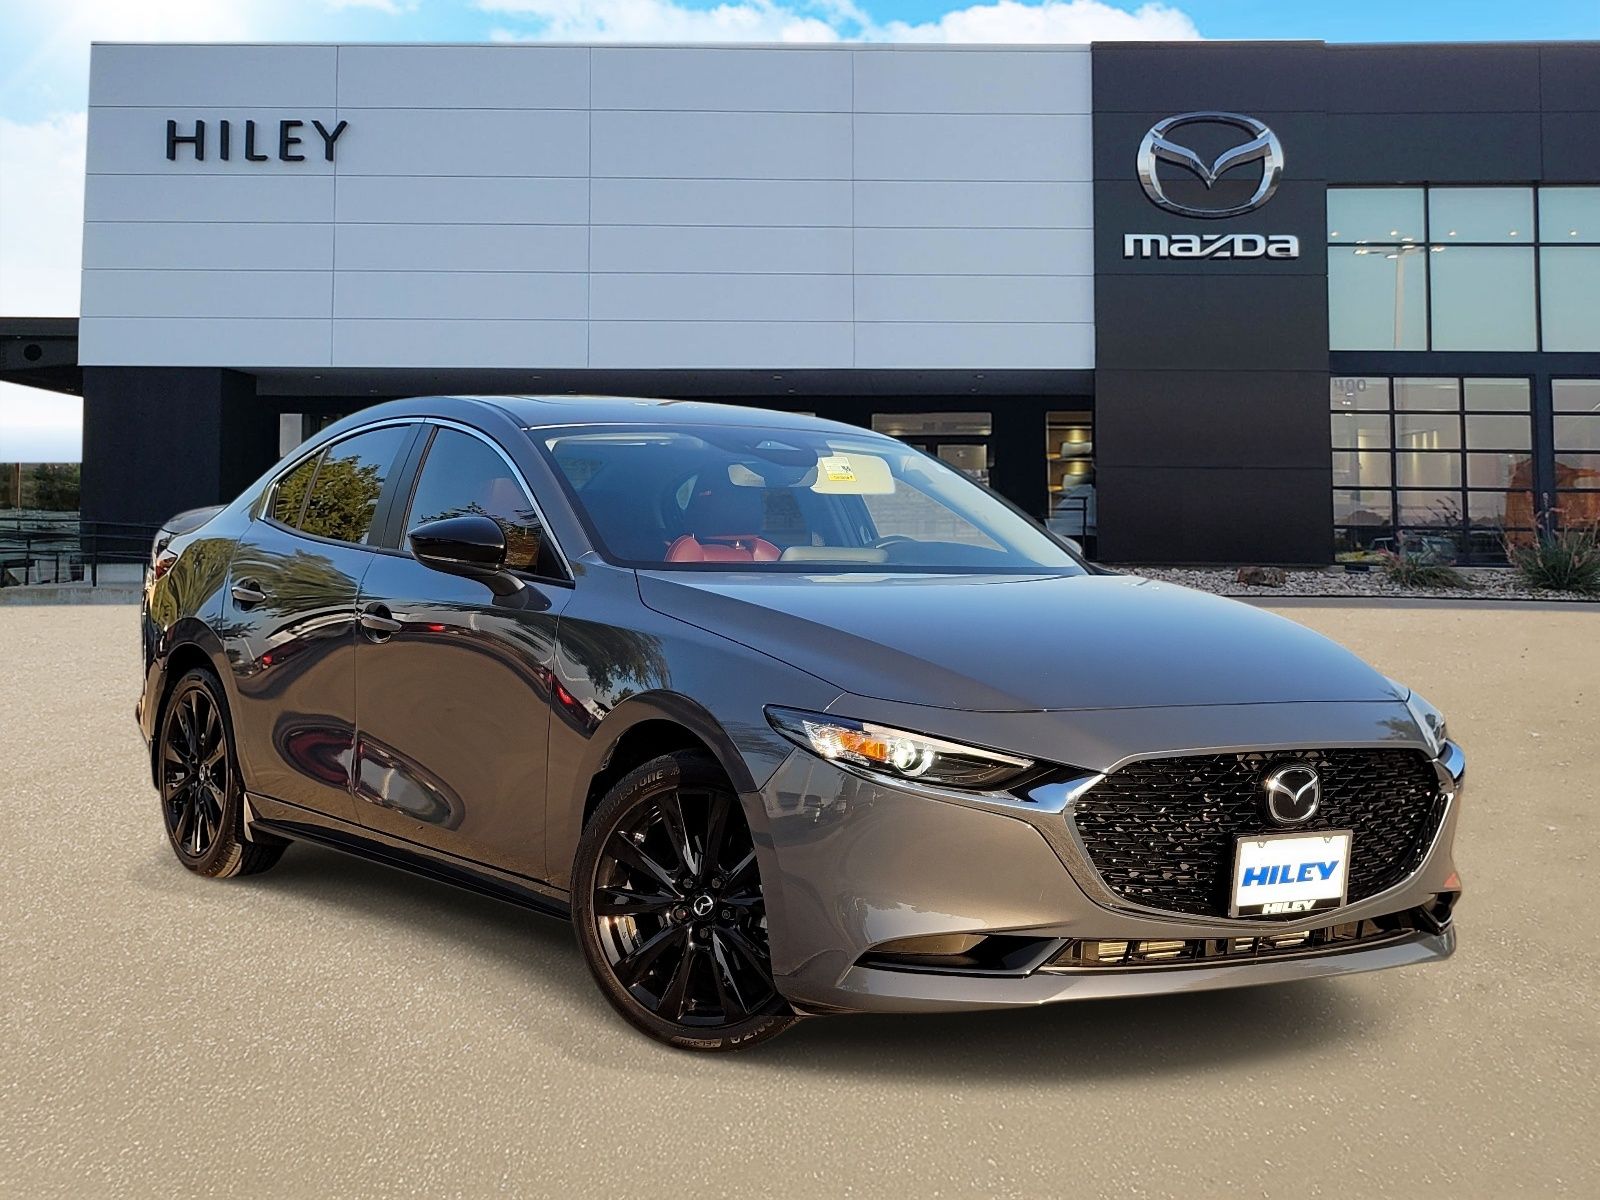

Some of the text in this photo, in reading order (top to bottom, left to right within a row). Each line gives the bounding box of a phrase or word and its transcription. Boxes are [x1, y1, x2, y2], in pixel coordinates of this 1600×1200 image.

[166, 119, 348, 162] HILEY
[1241, 860, 1340, 888] HILEY
[1261, 899, 1317, 915] HILEY
